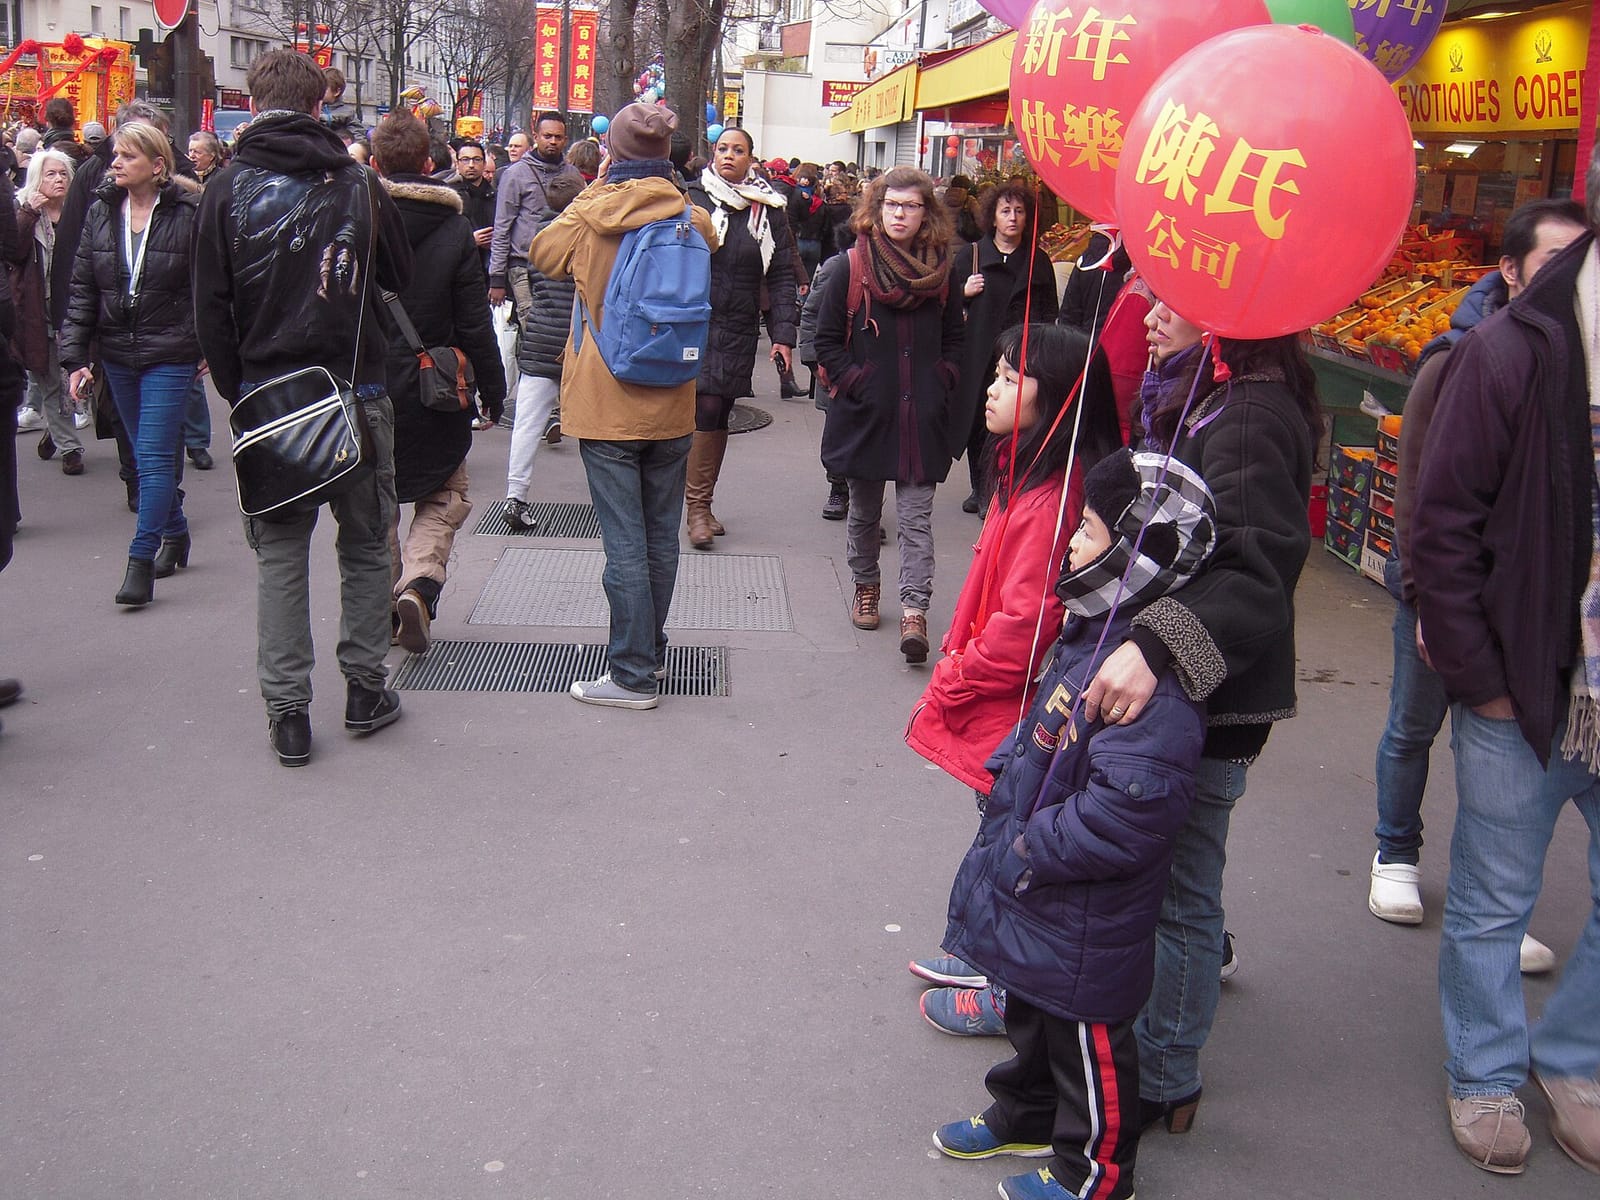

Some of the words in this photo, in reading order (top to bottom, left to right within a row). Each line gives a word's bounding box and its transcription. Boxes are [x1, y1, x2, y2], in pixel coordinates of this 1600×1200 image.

[538, 23, 558, 97] 如意吉祥
[573, 25, 592, 99] 百業興隆
[1020, 7, 1138, 81] 新年
[829, 83, 851, 91] THAI
[1398, 79, 1500, 124] EXOTIQUES
[1514, 69, 1586, 120] CORE
[1021, 98, 1125, 172] 快樂
[1135, 97, 1308, 240] 陳氏
[1145, 210, 1241, 289] 公司
